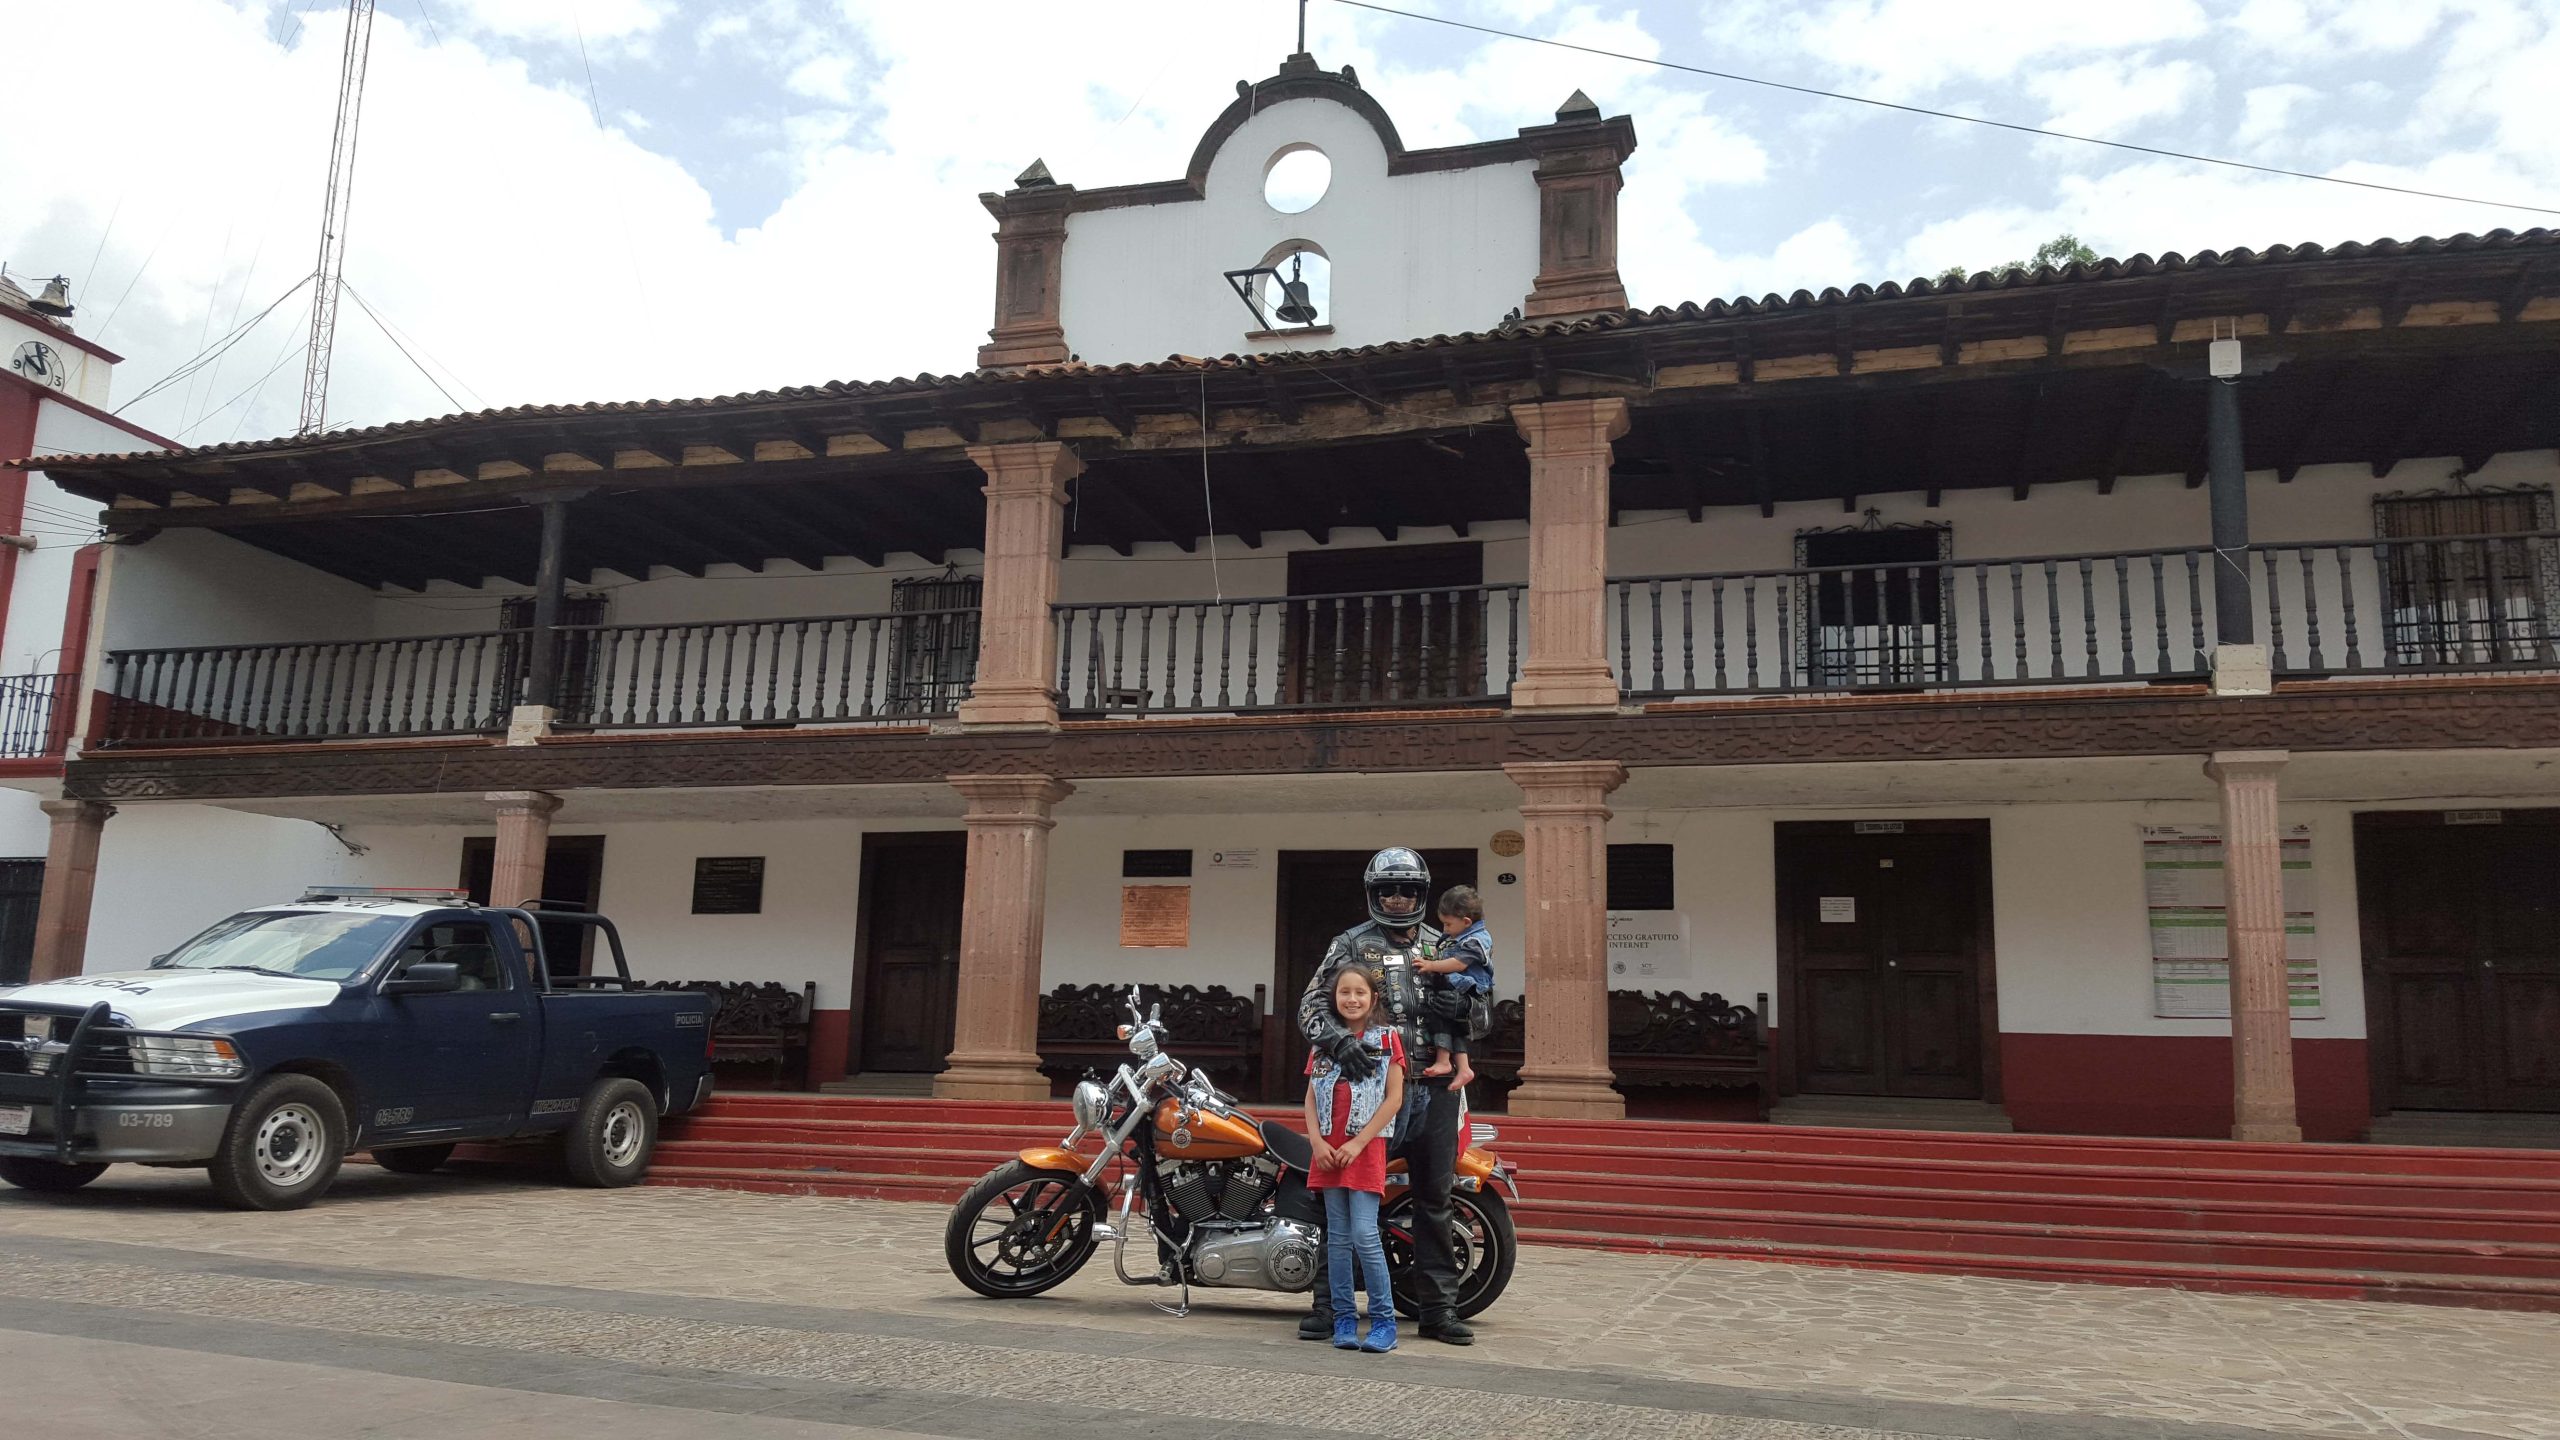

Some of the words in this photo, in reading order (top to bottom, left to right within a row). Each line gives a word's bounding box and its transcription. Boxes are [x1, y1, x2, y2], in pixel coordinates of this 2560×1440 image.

[13, 359, 21, 369] 9
[54, 375, 62, 386] 3
[1083, 750, 1289, 773] PRESIDENCIA
[1303, 747, 1481, 769] MUNICIPAL
[1635, 933, 1679, 941] GRATUITO
[676, 1015, 702, 1025] POLICIA
[119, 1112, 174, 1128] 03-789
[375, 1107, 414, 1126] 03-789
